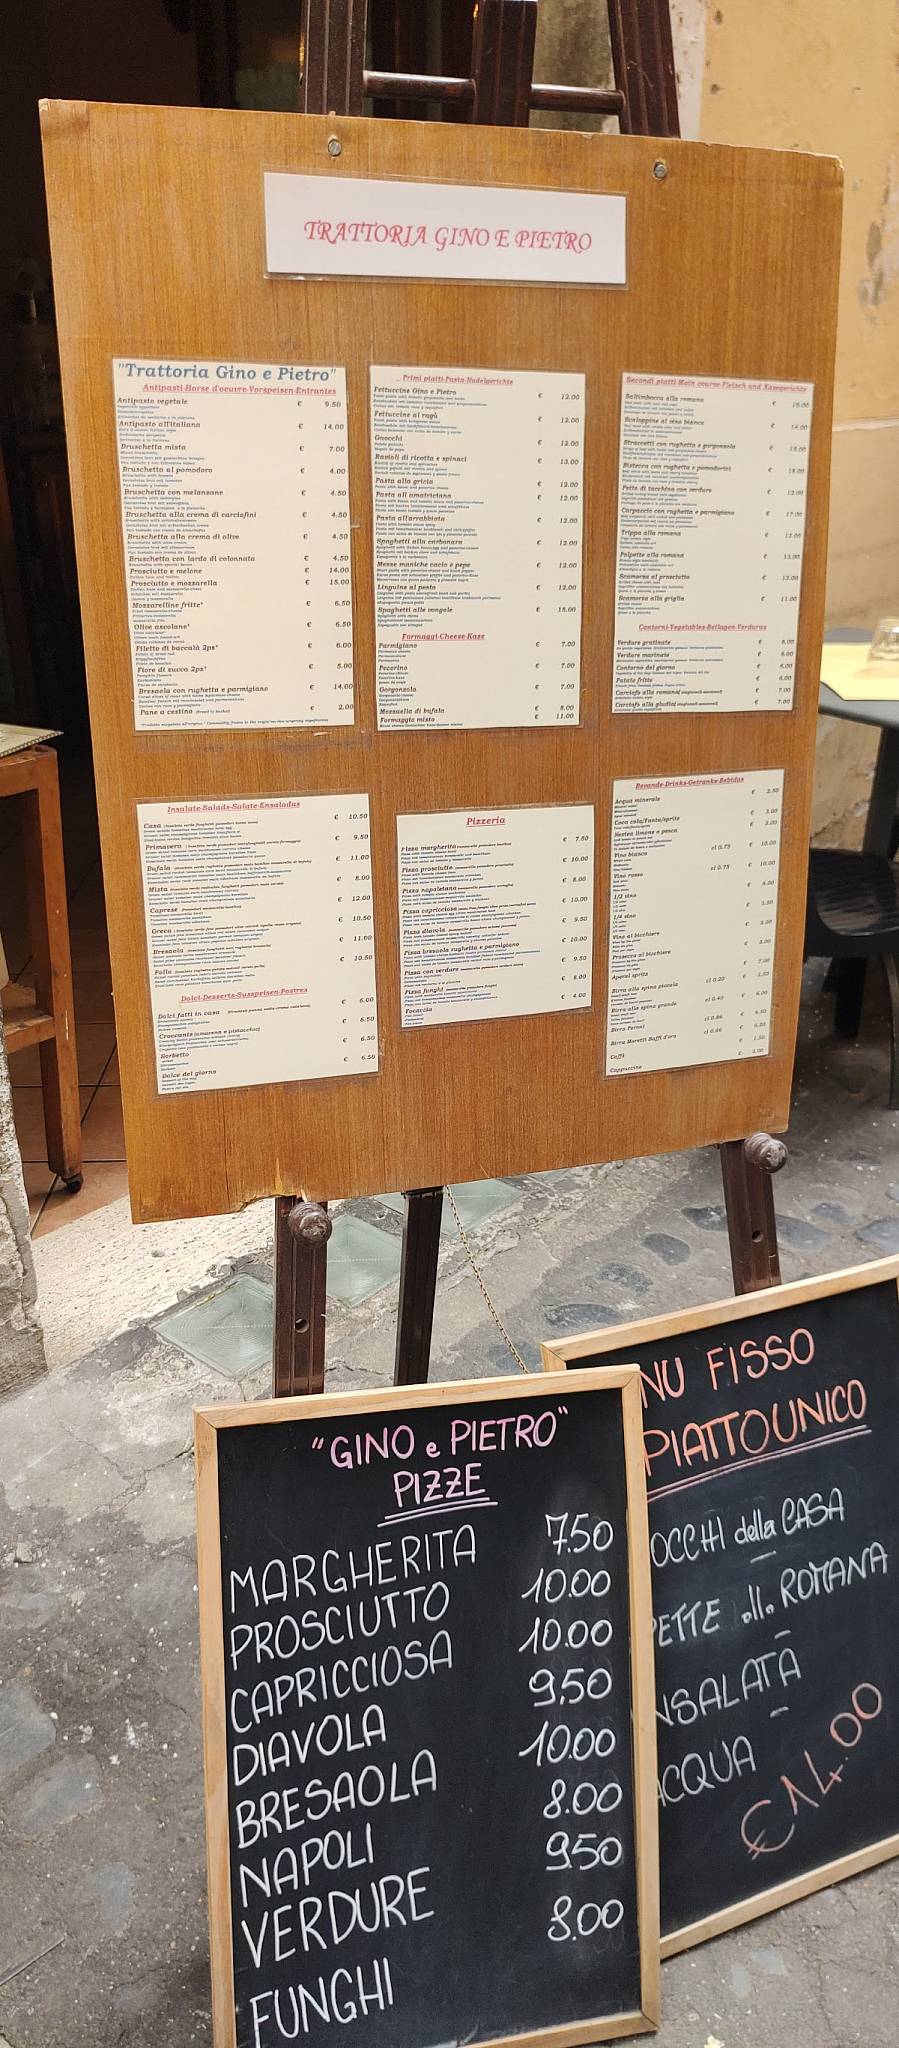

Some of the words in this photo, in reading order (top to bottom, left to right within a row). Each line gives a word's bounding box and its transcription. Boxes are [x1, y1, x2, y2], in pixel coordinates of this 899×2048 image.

[304, 220, 427, 248] TRATTORIA
[435, 228, 489, 251] GINO
[495, 230, 510, 247] E
[514, 230, 592, 253] PIETRO
[117, 397, 152, 405] Antipasto
[118, 363, 209, 378] "Trattoria
[216, 365, 256, 380] Gino
[263, 369, 272, 380] e
[278, 367, 336, 381] Pietro"
[403, 375, 421, 383] Primi
[119, 420, 155, 428] Antipasto
[221, 511, 256, 519] carciofini
[379, 642, 417, 650] Parmigiano
[188, 687, 219, 695] rughetta
[466, 816, 505, 827] Pizzeria
[707, 1328, 815, 1390] FISSO
[312, 1425, 415, 1469] "GINO
[426, 1442, 440, 1457] e
[451, 1406, 568, 1455] PIETRO"
[393, 1463, 486, 1508] PIZZE
[650, 1516, 726, 1568] OCCHI
[734, 1509, 777, 1544] della
[781, 1488, 844, 1536] CASA
[229, 1524, 476, 1613] MARGHERITA
[546, 1512, 613, 1555] 7.50
[741, 1584, 775, 1624] alla
[780, 1541, 888, 1608] ROMANA
[230, 1581, 450, 1670] PROSCIUTTO
[522, 1568, 611, 1603] 10.00
[230, 1630, 453, 1733] CAPRICCIOSA
[519, 1617, 613, 1654] 10.00
[233, 1704, 386, 1786] DIAVOLA
[236, 1749, 437, 1849] BRESAOLA
[519, 1720, 616, 1766] 10.00
[239, 1823, 373, 1907] NAPOLI
[543, 1779, 623, 1819] 8.00
[241, 1867, 434, 1968] VERDURE
[250, 1957, 393, 2048] FUNGHI
[548, 1896, 624, 1942] 8.00
